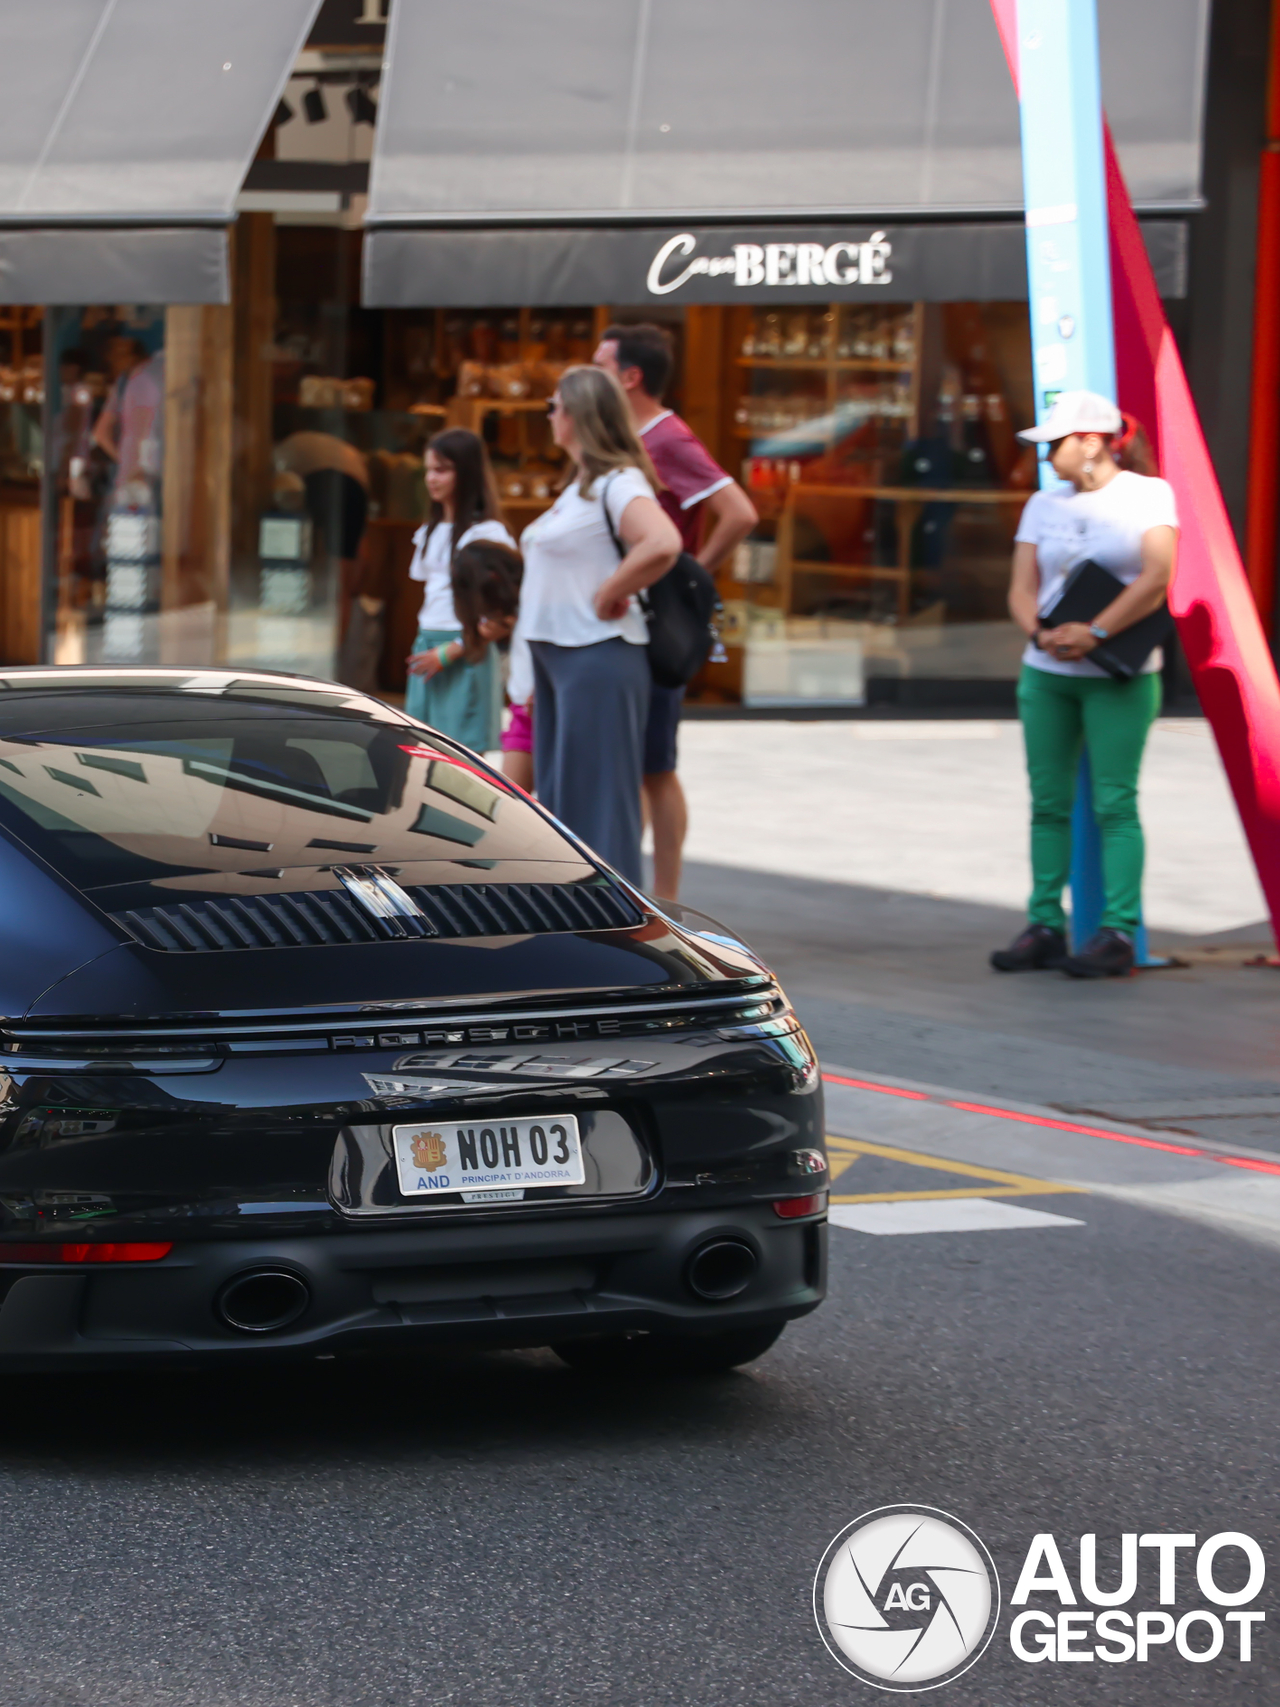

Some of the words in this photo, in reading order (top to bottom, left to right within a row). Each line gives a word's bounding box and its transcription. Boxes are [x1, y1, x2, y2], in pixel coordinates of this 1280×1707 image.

[331, 1019, 620, 1050] PORSCHE
[456, 1126, 521, 1171] NOH
[529, 1124, 570, 1166] 03
[417, 1175, 450, 1190] AND
[462, 1173, 512, 1184] PRINCIPAT
[514, 1169, 570, 1181] D'ANDORRA
